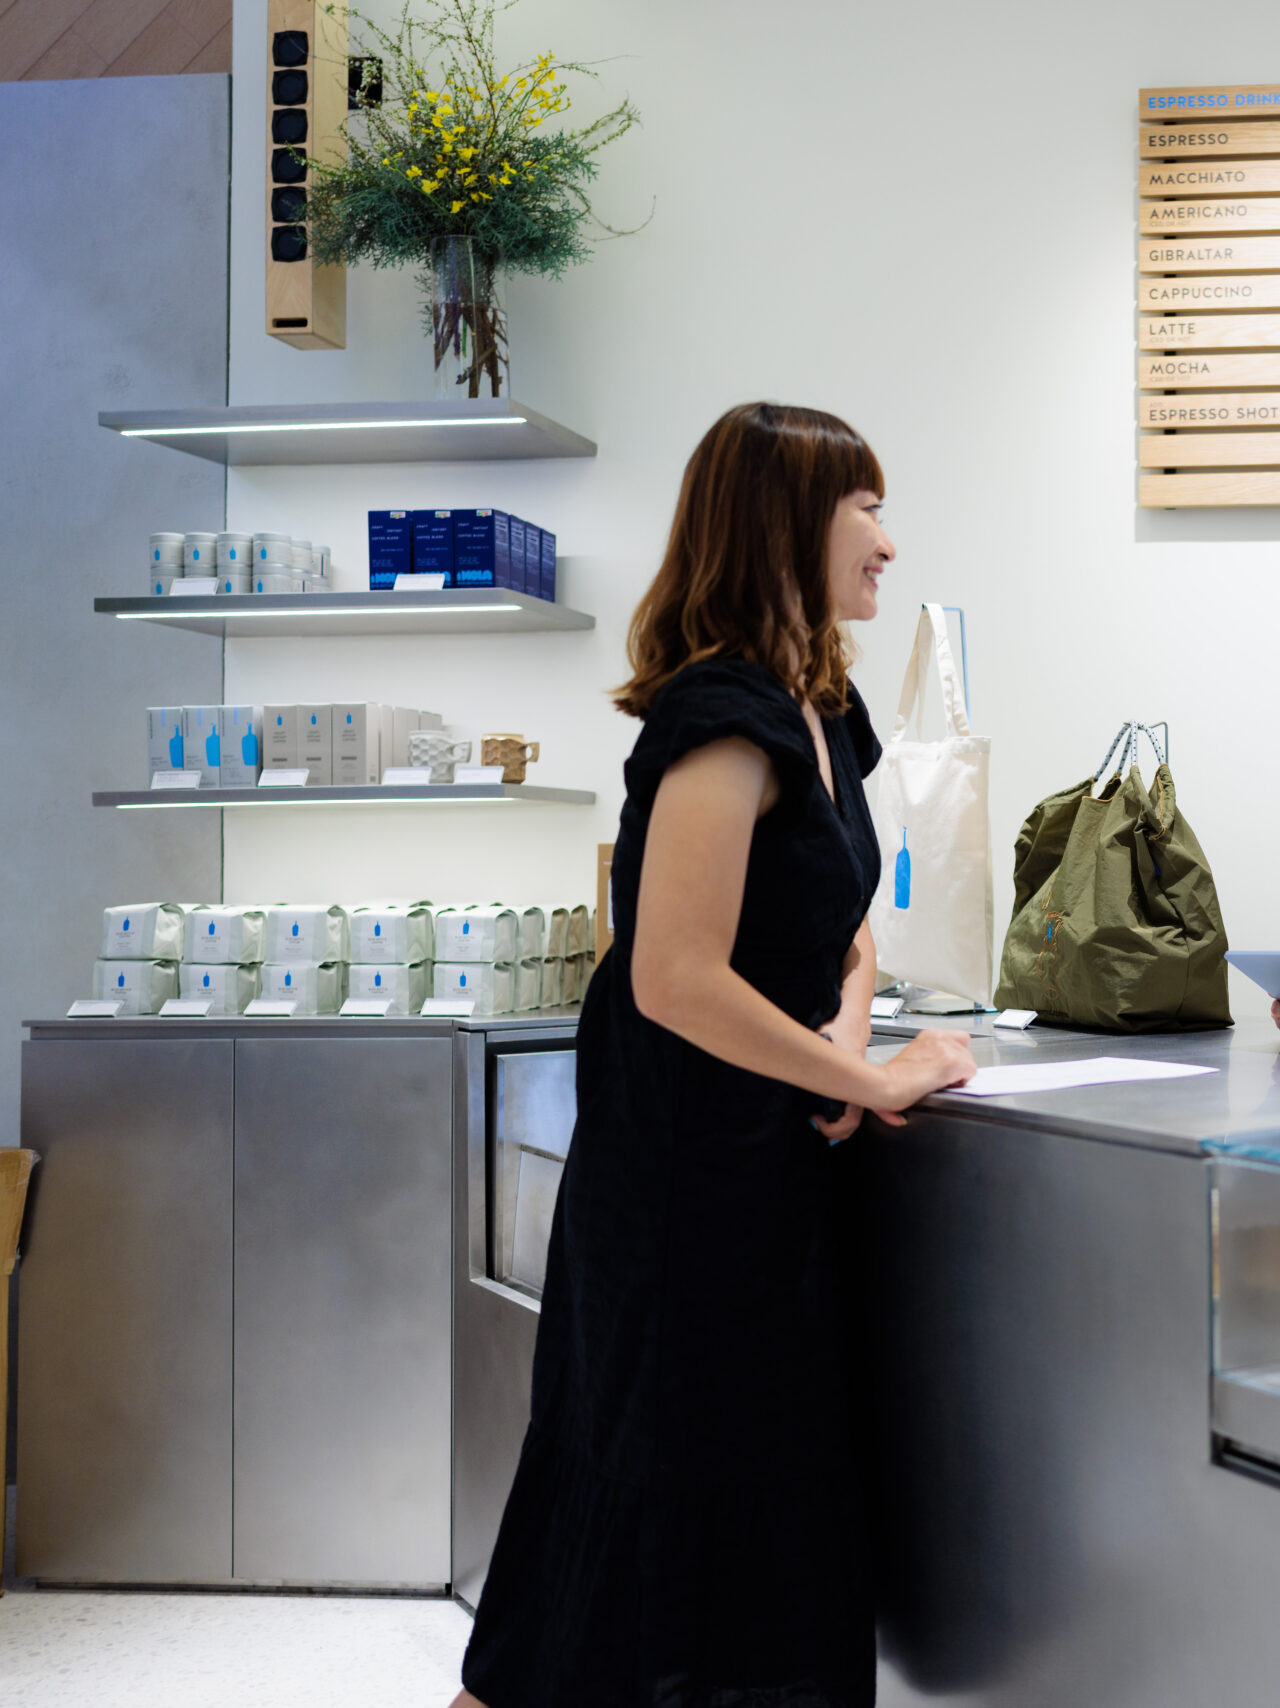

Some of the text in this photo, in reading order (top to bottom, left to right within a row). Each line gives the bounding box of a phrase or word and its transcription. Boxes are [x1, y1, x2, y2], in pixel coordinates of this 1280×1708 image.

[1148, 95, 1229, 109] ESPRESSO
[1148, 133, 1229, 147] ESPRESSO
[1149, 170, 1246, 185] MACCHIATO
[1150, 205, 1248, 220] AMERICANO
[1149, 248, 1233, 262] GIBRALTAR
[1149, 286, 1253, 300] CAPPUCCINO
[1149, 322, 1196, 335] LATTE
[1150, 362, 1211, 375] MOCHA
[1149, 406, 1279, 421] ESPRESSO SHOT
